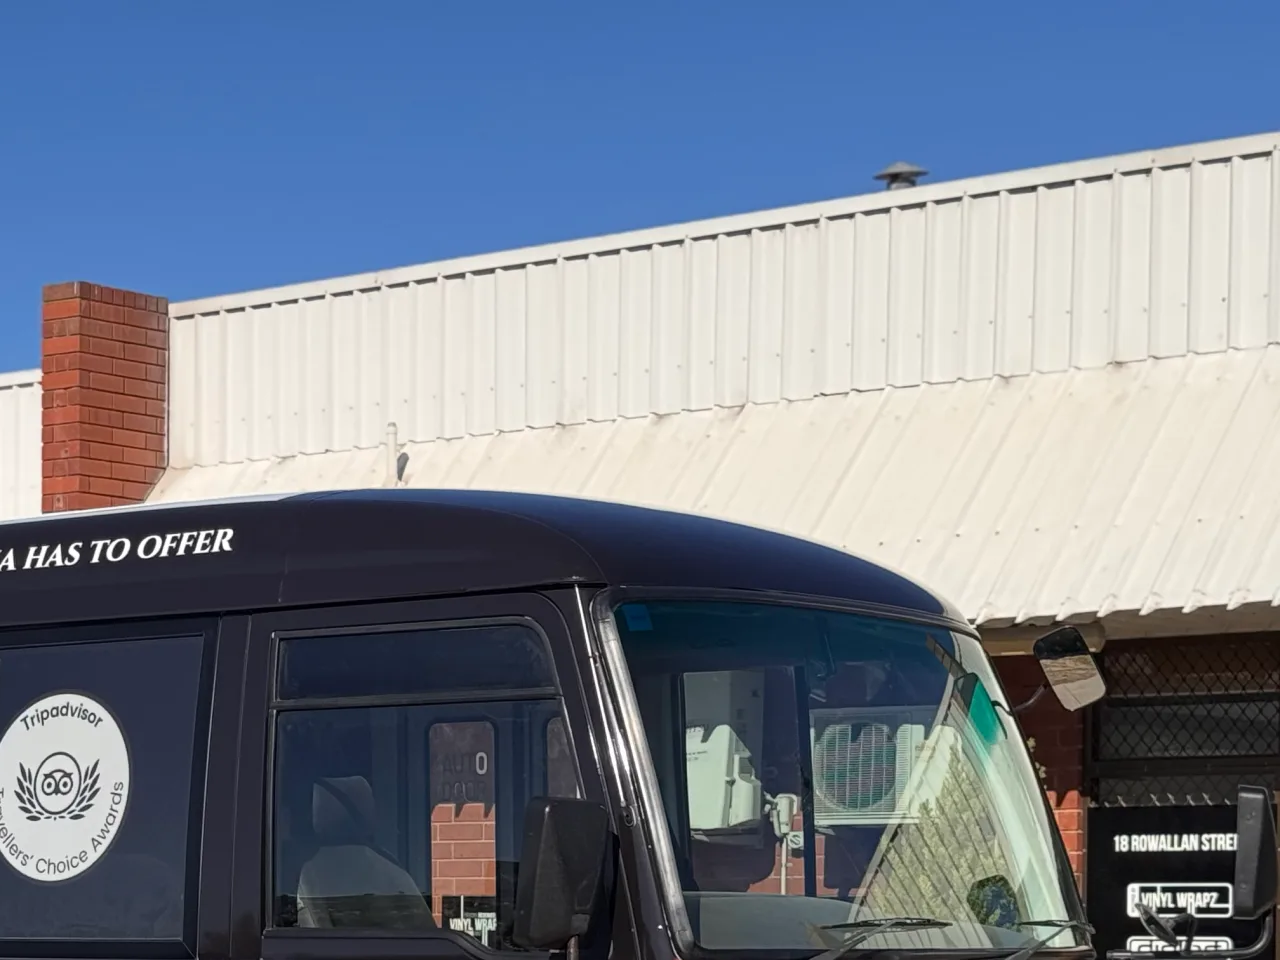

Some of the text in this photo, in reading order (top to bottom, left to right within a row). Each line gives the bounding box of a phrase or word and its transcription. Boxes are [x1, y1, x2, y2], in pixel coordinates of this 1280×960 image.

[22, 542, 83, 570] HAS
[90, 537, 131, 564] TO
[137, 528, 234, 559] OFFER
[20, 701, 104, 731] Tripadvisor
[35, 850, 88, 875] Choice
[91, 781, 124, 853] Awards
[1113, 834, 1129, 852] 18
[1131, 833, 1199, 852] ROWALLAN
[1141, 892, 1175, 909] VINYL
[1176, 892, 1220, 909] WRAPZ
[449, 918, 473, 931] VINYL
